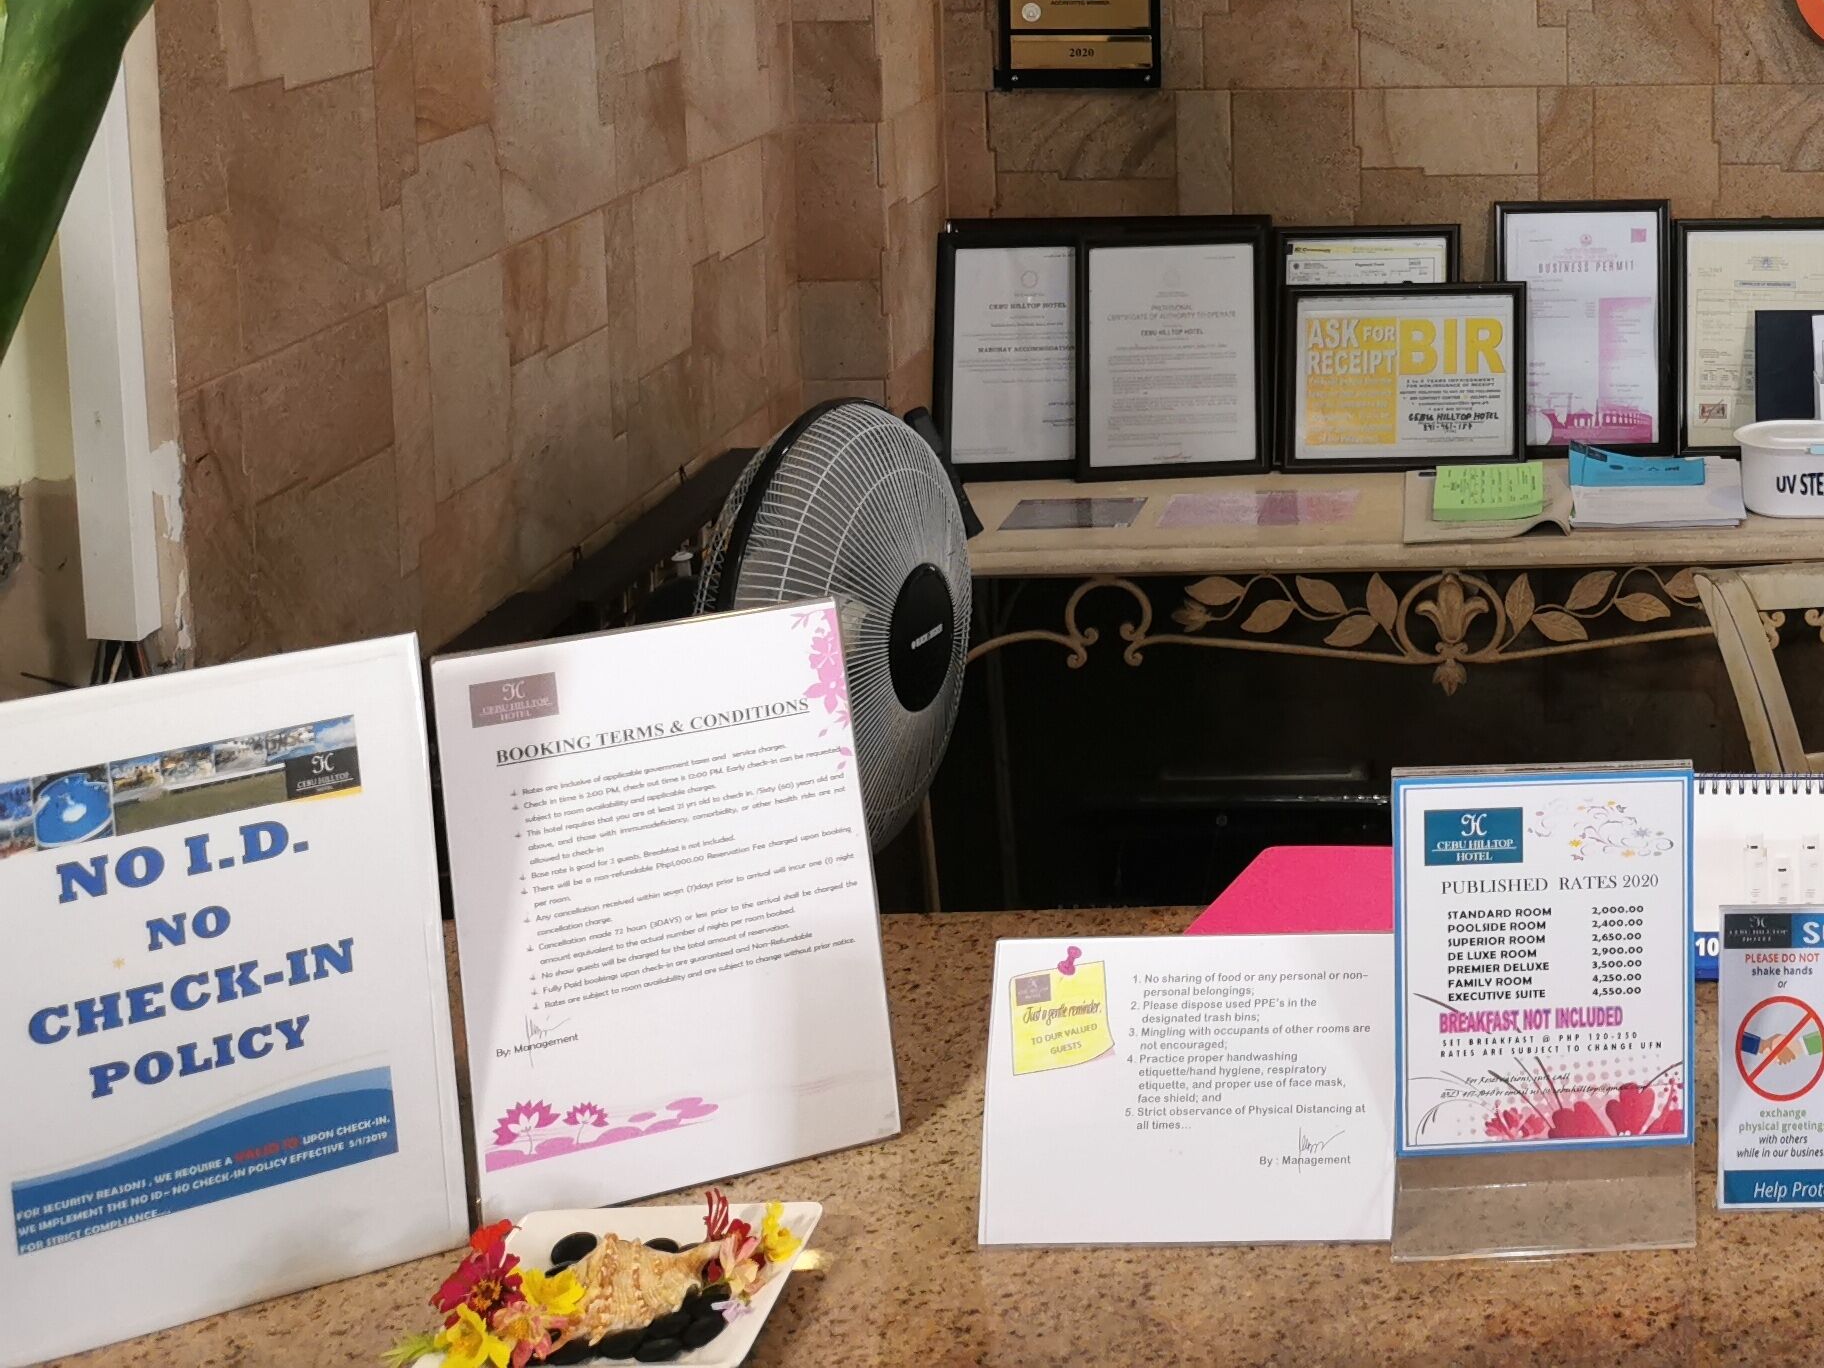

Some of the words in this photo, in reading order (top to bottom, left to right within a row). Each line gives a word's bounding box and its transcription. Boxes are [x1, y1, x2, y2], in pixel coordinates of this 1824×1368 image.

[1068, 47, 1096, 58] 2020
[1537, 260, 1590, 274] BUSINESS
[1594, 259, 1636, 272] PERMIT
[1307, 318, 1360, 348] ASK
[1363, 326, 1396, 342] FOR
[1399, 317, 1505, 375] BIR
[1307, 349, 1397, 376] RECEIPT
[1775, 474, 1797, 495] UV
[496, 736, 591, 764] BOOKING
[599, 723, 665, 747] TERMS
[669, 719, 685, 735] &
[690, 697, 811, 731] CONDITIONS
[1436, 839, 1466, 850] CEBU
[1468, 838, 1514, 849] HILLTOP
[56, 845, 164, 904] NO
[187, 820, 310, 876] I.D.
[1455, 851, 1494, 862] HOTEL
[1441, 877, 1549, 895] PUBLISHED
[1559, 875, 1618, 891] RATES
[1622, 874, 1659, 889] 2020
[1447, 908, 1512, 920] STANDARD
[1514, 907, 1552, 918] ROOM
[1591, 904, 1645, 916] 2,000.00
[146, 905, 231, 952] NO
[1447, 922, 1507, 934] POOLSIDE
[1509, 920, 1547, 931] ROOM
[1591, 918, 1644, 929] 2,400.00
[1447, 936, 1506, 948] SUPERIOR
[1508, 934, 1546, 945] ROOM
[1591, 932, 1643, 943] 2,650.00
[1447, 951, 1464, 962] DE
[1466, 950, 1497, 961] LUXE
[1499, 948, 1537, 960] ROOM
[1591, 945, 1644, 957] 2,900.00
[1744, 953, 1779, 964] PLEASE
[1781, 953, 1797, 963] DO
[1799, 952, 1820, 963] NOT
[1447, 963, 1501, 975] PREMIER
[1503, 961, 1550, 973] DELUXE
[1591, 959, 1643, 970] 3,500.00
[1751, 965, 1782, 977] shake
[1783, 965, 1814, 976] hands
[1132, 973, 1142, 985] 1.
[1144, 973, 1161, 984] No
[1161, 973, 1203, 985] sharing
[1204, 972, 1217, 983] of
[1217, 971, 1243, 983] food
[1243, 973, 1256, 983] or
[1257, 973, 1279, 984] any
[1279, 970, 1327, 983] personal
[1328, 972, 1341, 981] or
[1342, 971, 1369, 981] non-
[1447, 977, 1493, 989] FAMILY
[1495, 976, 1533, 987] ROOM
[1591, 972, 1643, 984] 4,250.00
[1776, 979, 1788, 989] or
[28, 938, 355, 1046] CHECK-IN
[1142, 986, 1191, 999] personal
[1192, 985, 1255, 998] belongings;
[1447, 990, 1512, 1002] EXECUTIVE
[1515, 988, 1546, 1000] SUITE
[1591, 986, 1642, 998] 4,550.00
[1142, 1000, 1179, 1011] Please
[1180, 999, 1223, 1012] dispose
[1224, 998, 1252, 1009] used
[1253, 997, 1286, 1009] PPE's
[1287, 998, 1298, 1008] in
[1299, 997, 1318, 1008] the
[1439, 1011, 1519, 1033] BREAKFAST
[1523, 1009, 1551, 1030] NOT
[1555, 1006, 1624, 1029] INCLUDED
[514, 1033, 579, 1054] Management
[1050, 1041, 1082, 1054] GUESTS
[89, 1015, 311, 1099] POLICY
[1753, 1180, 1787, 1202] Help
